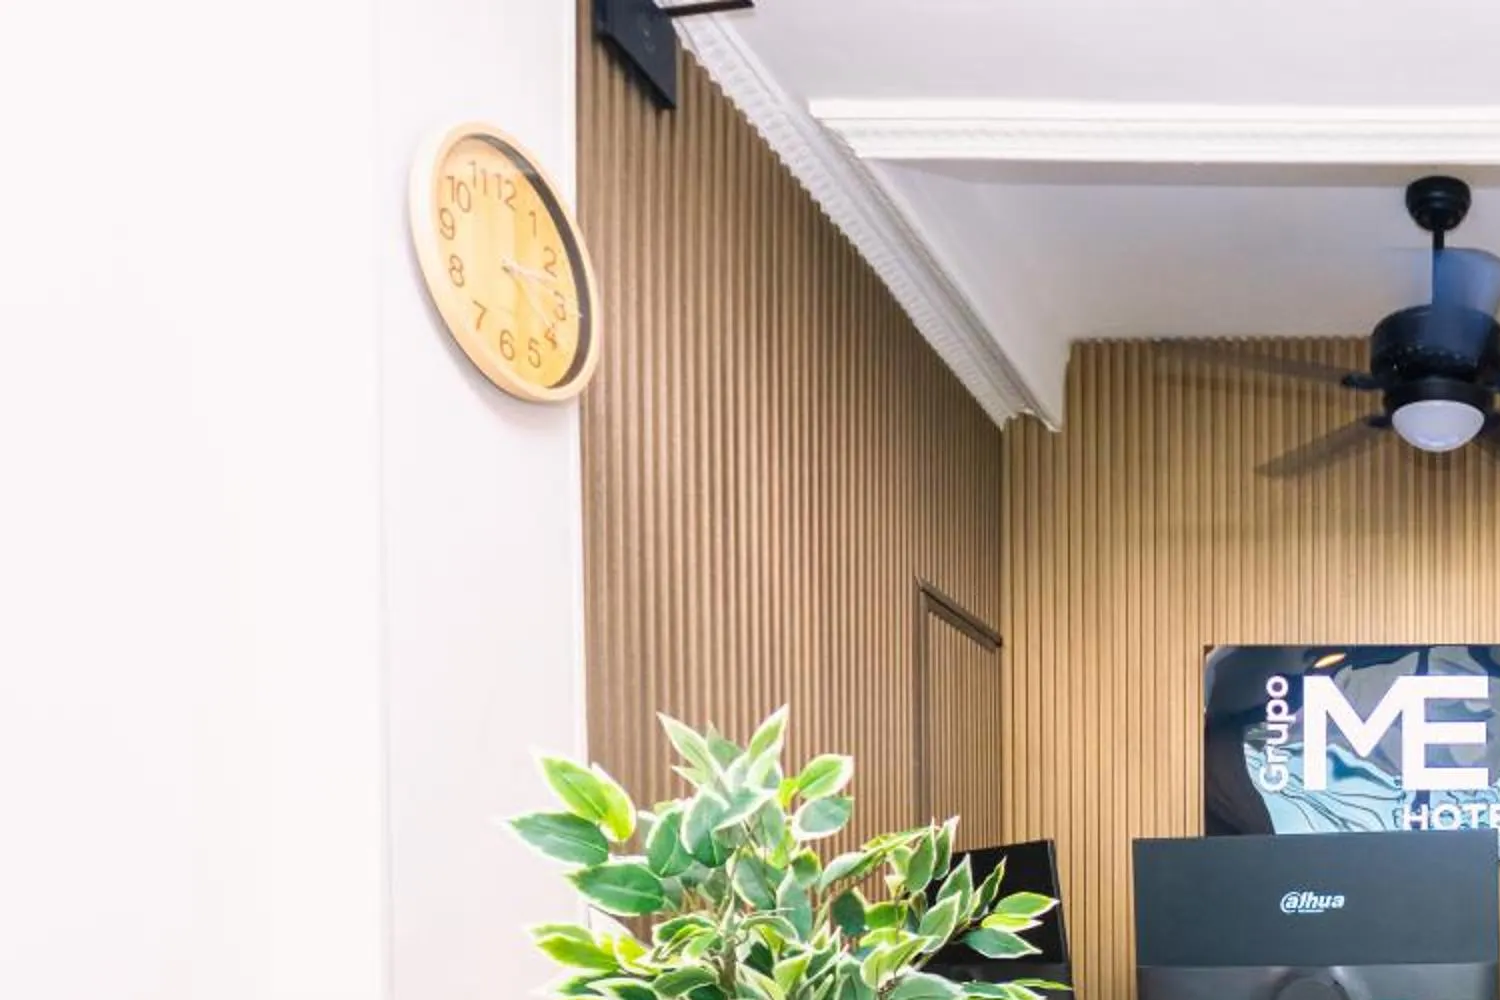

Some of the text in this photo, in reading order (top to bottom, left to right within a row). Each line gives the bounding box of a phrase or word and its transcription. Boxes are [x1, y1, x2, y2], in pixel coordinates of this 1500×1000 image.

[446, 175, 472, 213] 10
[468, 160, 489, 196] 11
[495, 173, 517, 211] 12
[439, 206, 456, 240] 9
[528, 210, 538, 238] 1
[448, 253, 466, 288] 8
[544, 246, 558, 278] 2
[471, 299, 488, 331] 7
[499, 329, 516, 361] 6
[527, 337, 542, 369] 5
[1260, 675, 1297, 792] Grupo
